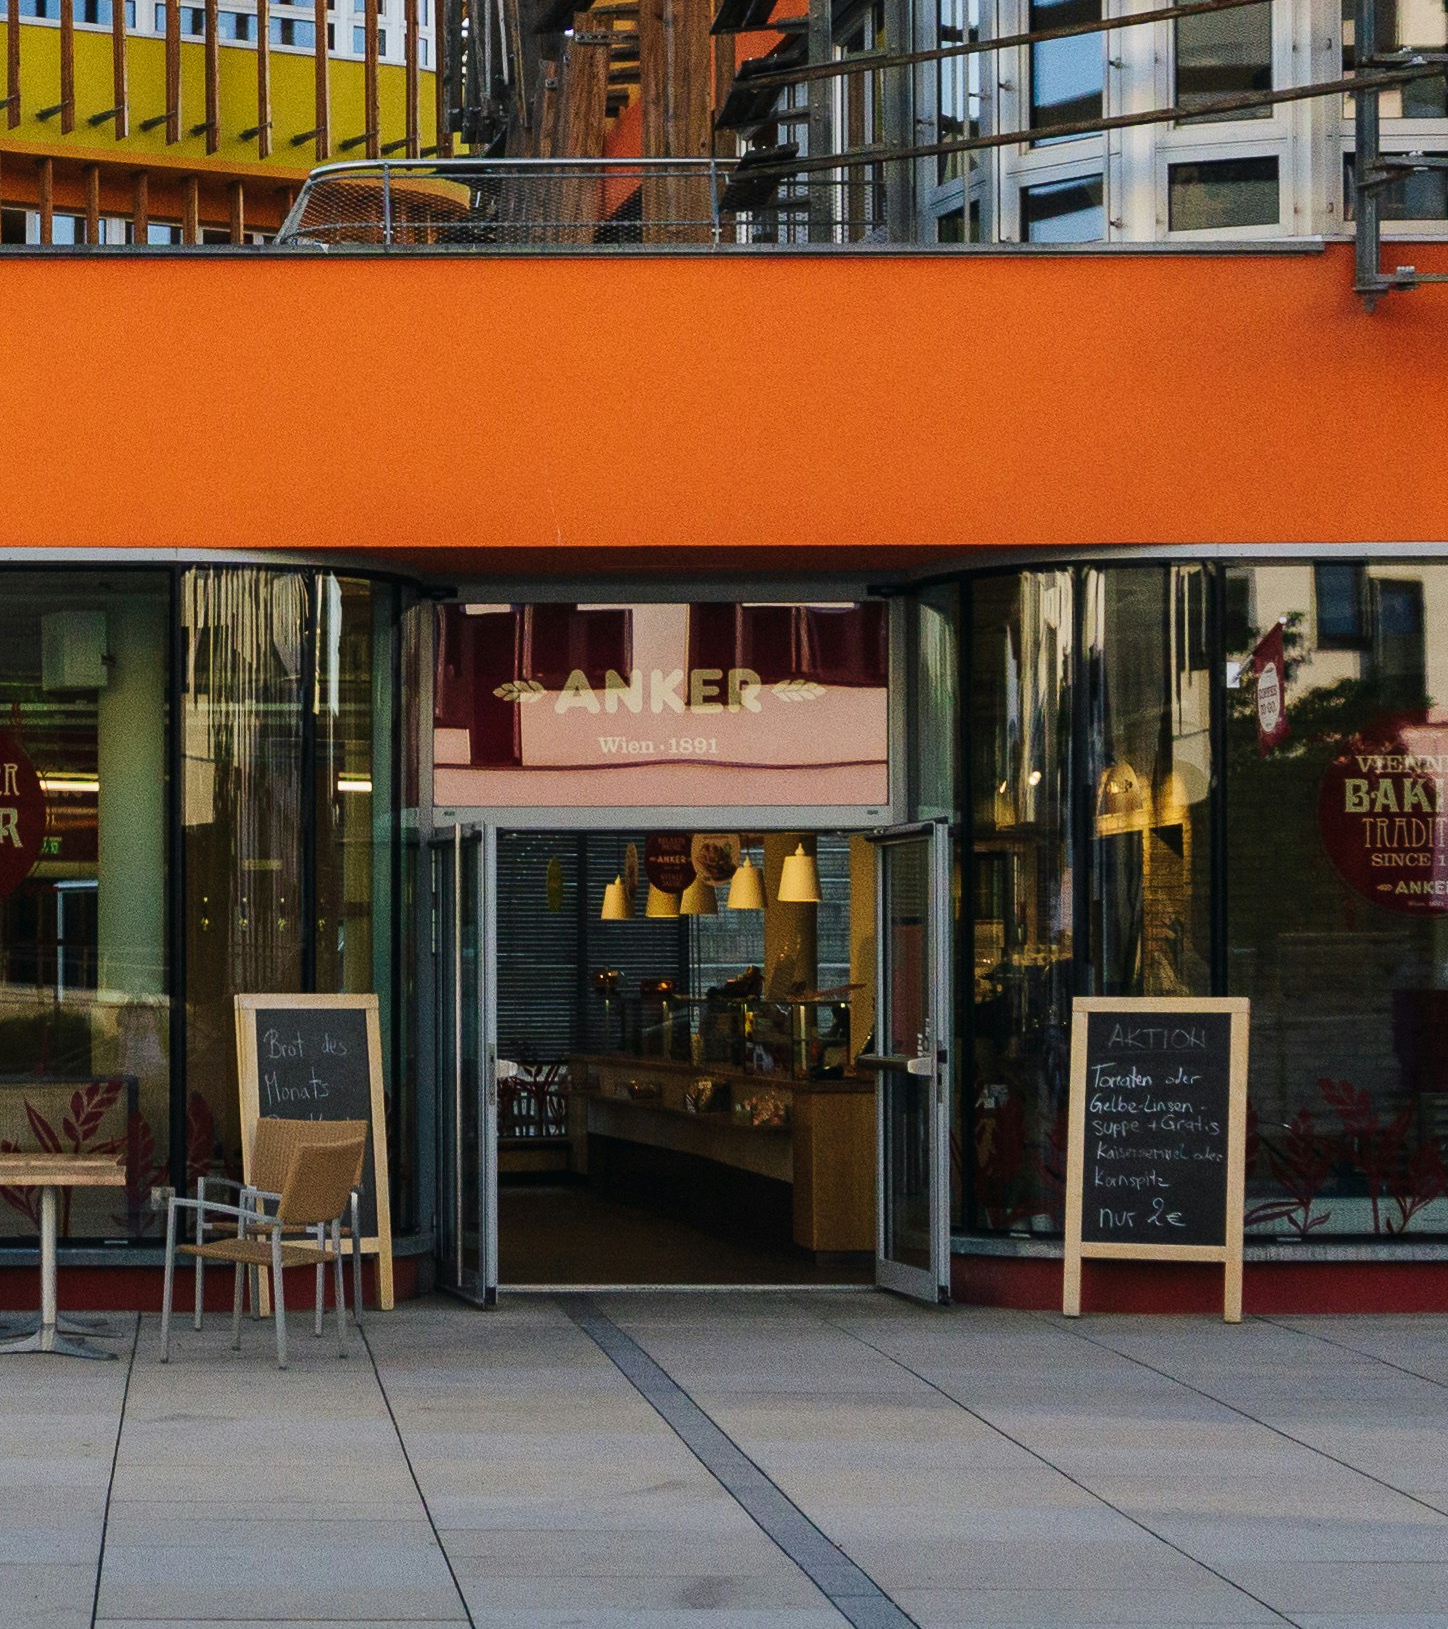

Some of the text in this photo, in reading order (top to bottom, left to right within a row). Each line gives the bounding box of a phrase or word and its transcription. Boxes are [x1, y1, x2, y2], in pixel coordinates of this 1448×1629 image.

[554, 668, 763, 713] ANKER
[597, 737, 719, 754] Wien 1891
[1371, 853, 1432, 867] SINCE
[263, 1028, 348, 1059] Brot des
[1108, 1023, 1207, 1050] AKTION
[264, 1066, 330, 1107] Monats
[1091, 1062, 1201, 1089] Tomaten oder
[1099, 1208, 1136, 1228] nur
